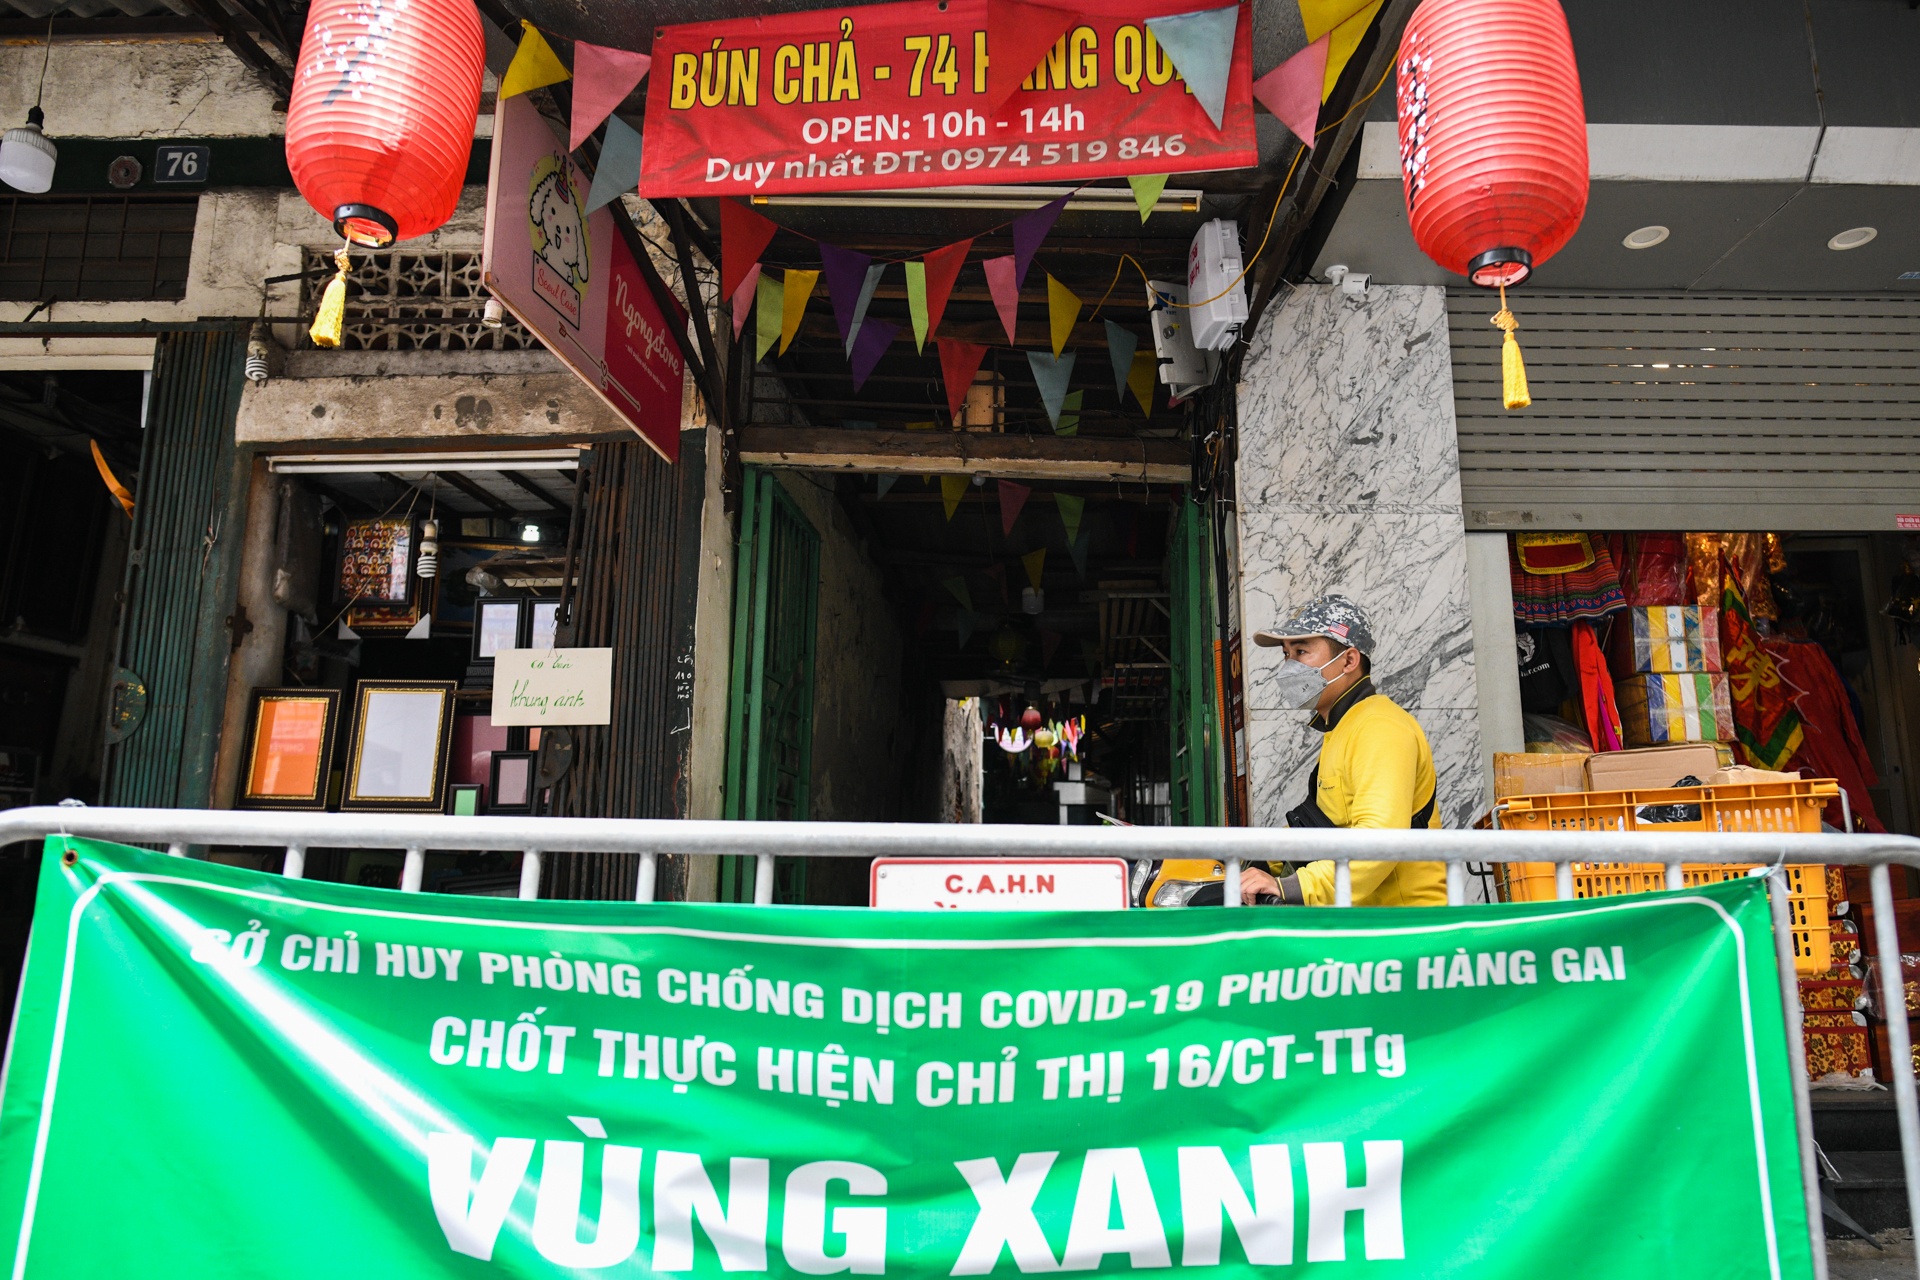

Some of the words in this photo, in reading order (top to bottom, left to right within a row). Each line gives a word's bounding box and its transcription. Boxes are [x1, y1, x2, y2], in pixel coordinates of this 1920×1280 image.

[669, 38, 760, 110] BÚN
[772, 17, 861, 105] CHẢ
[873, 65, 892, 81] -
[904, 33, 960, 97] 74
[973, 24, 1099, 94] HNG
[802, 113, 910, 144] OPEN:
[922, 109, 986, 139] 10h
[996, 120, 1008, 128] -
[1020, 103, 1085, 133] 14h
[167, 152, 198, 177] 76
[705, 157, 775, 189] Duy
[783, 148, 863, 179] nhất
[873, 150, 931, 175] ĐT:
[941, 144, 1031, 171] 0974
[1041, 140, 1108, 166] 519
[1118, 134, 1187, 159] 846
[537, 268, 559, 299] Seoul
[560, 289, 577, 315] Case
[945, 874, 1055, 894] C.A.H.N
[281, 930, 360, 974] CHỈ
[375, 942, 464, 982] HUY
[479, 949, 642, 999] PHÒNG
[657, 964, 824, 1020] CHỐNG
[841, 987, 962, 1035] DỊCH
[979, 983, 1204, 1030] COVID-19
[1217, 958, 1401, 1008] PHƯỜNG
[1416, 946, 1538, 991] HÀNG
[1550, 945, 1626, 982] GAI
[429, 1006, 576, 1075] CHỐT
[592, 1028, 737, 1094] THỰC
[757, 1043, 894, 1108] HIỆN
[916, 1045, 1019, 1108] CHỈ
[1036, 1051, 1124, 1104] THỊ
[1146, 1027, 1407, 1091] 16/CT-TTg
[427, 1115, 889, 1276] VÙNG
[948, 1138, 1407, 1277] XANH
